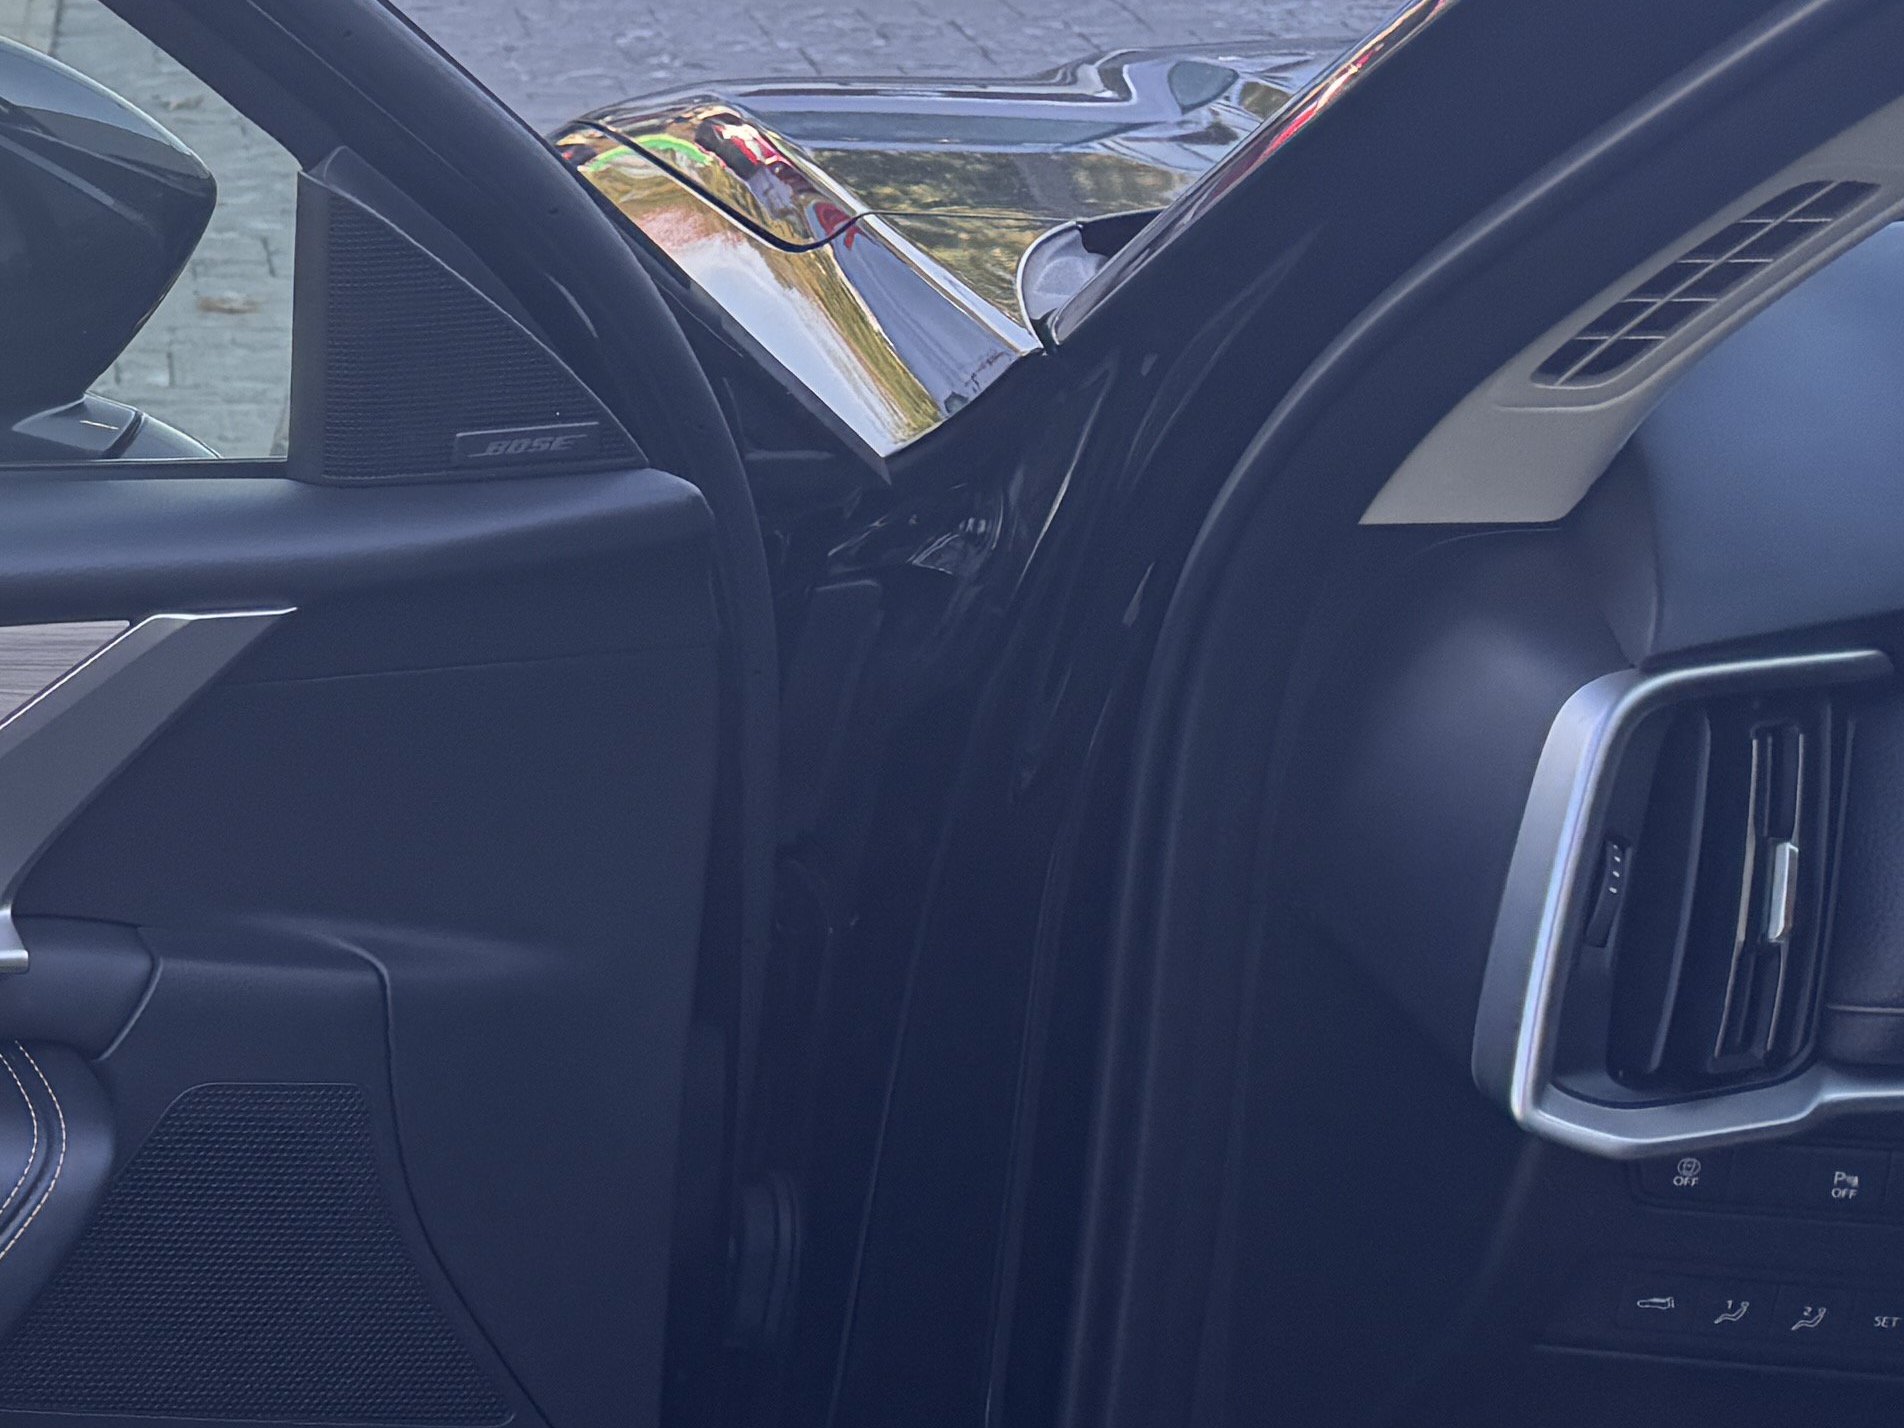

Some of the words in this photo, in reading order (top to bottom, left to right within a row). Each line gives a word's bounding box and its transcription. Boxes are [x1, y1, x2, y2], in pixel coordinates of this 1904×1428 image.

[476, 425, 583, 457] BOSE
[1672, 1175, 1700, 1187] OFF
[1831, 1187, 1858, 1200] OFF
[1803, 1306, 1812, 1317] 2
[1873, 1315, 1901, 1329] SET
